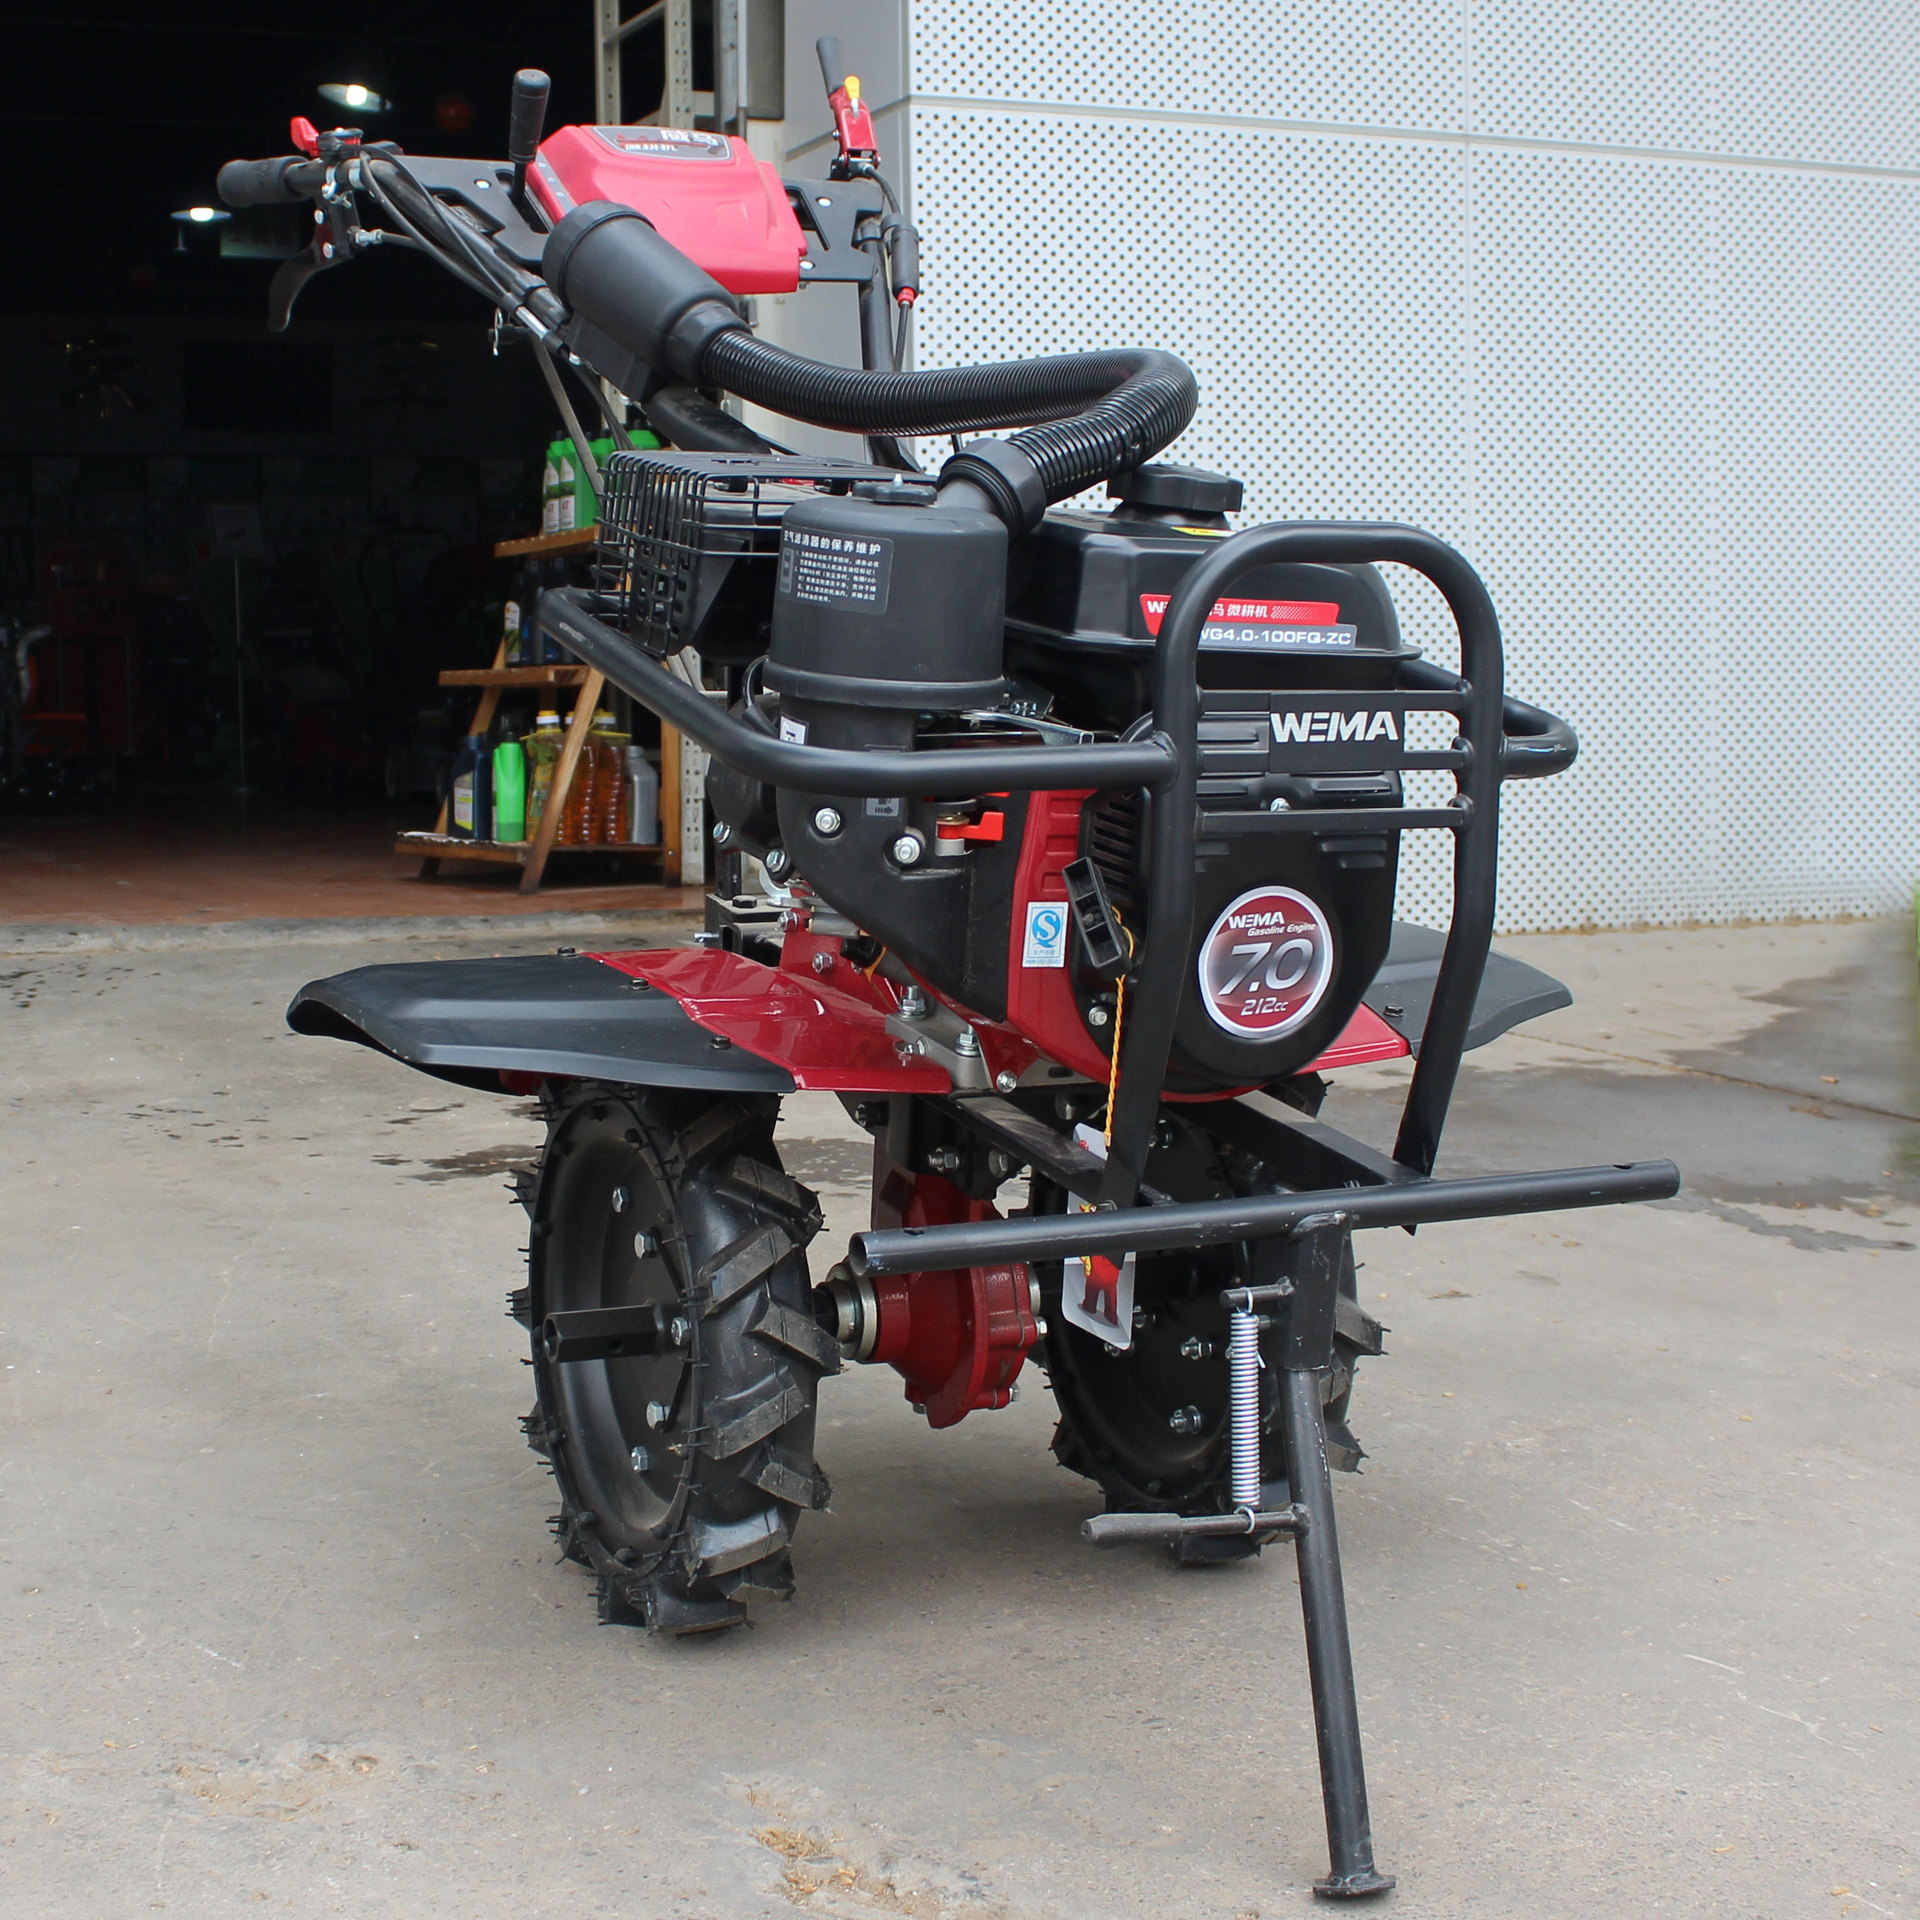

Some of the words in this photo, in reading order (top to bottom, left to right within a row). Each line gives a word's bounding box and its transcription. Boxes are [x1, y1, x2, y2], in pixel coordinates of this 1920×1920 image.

[783, 530, 881, 555] 空气滤清器的保养维护
[1209, 603, 1225, 616] 马
[1227, 604, 1268, 617] 微耕机
[1247, 926, 1285, 937] Gasoline
[1286, 923, 1317, 934] Engine
[1217, 938, 1314, 996] 7.0
[1240, 997, 1289, 1017] 212cc
